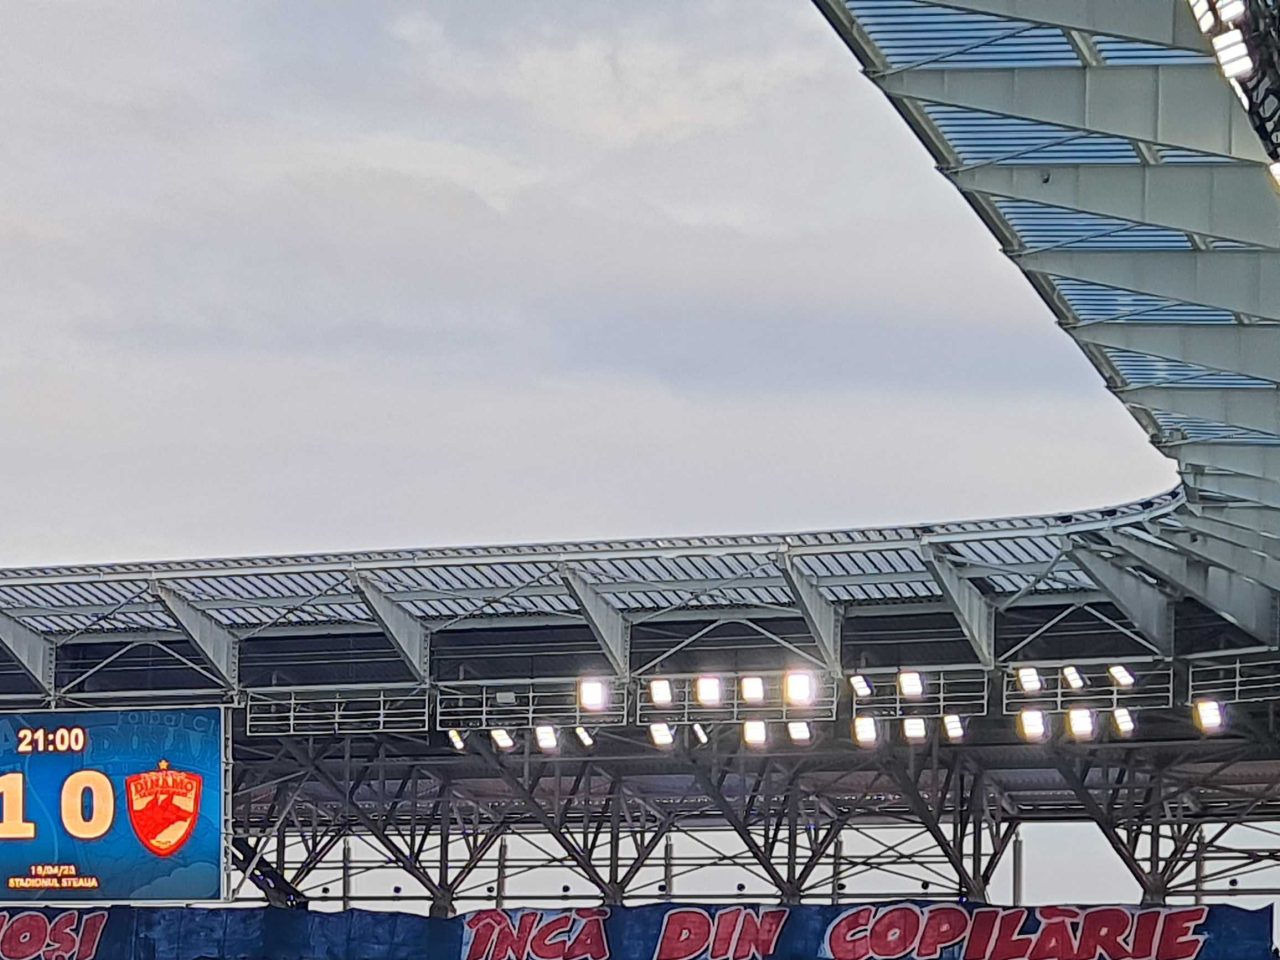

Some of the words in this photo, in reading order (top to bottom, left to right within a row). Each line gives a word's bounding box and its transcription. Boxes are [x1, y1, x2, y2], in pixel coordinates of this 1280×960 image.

[18, 728, 84, 752] 21:00
[134, 777, 194, 793] DINAMO
[61, 770, 114, 838] 0
[8, 878, 60, 888] STADIONUL
[61, 878, 98, 888] STEAUA
